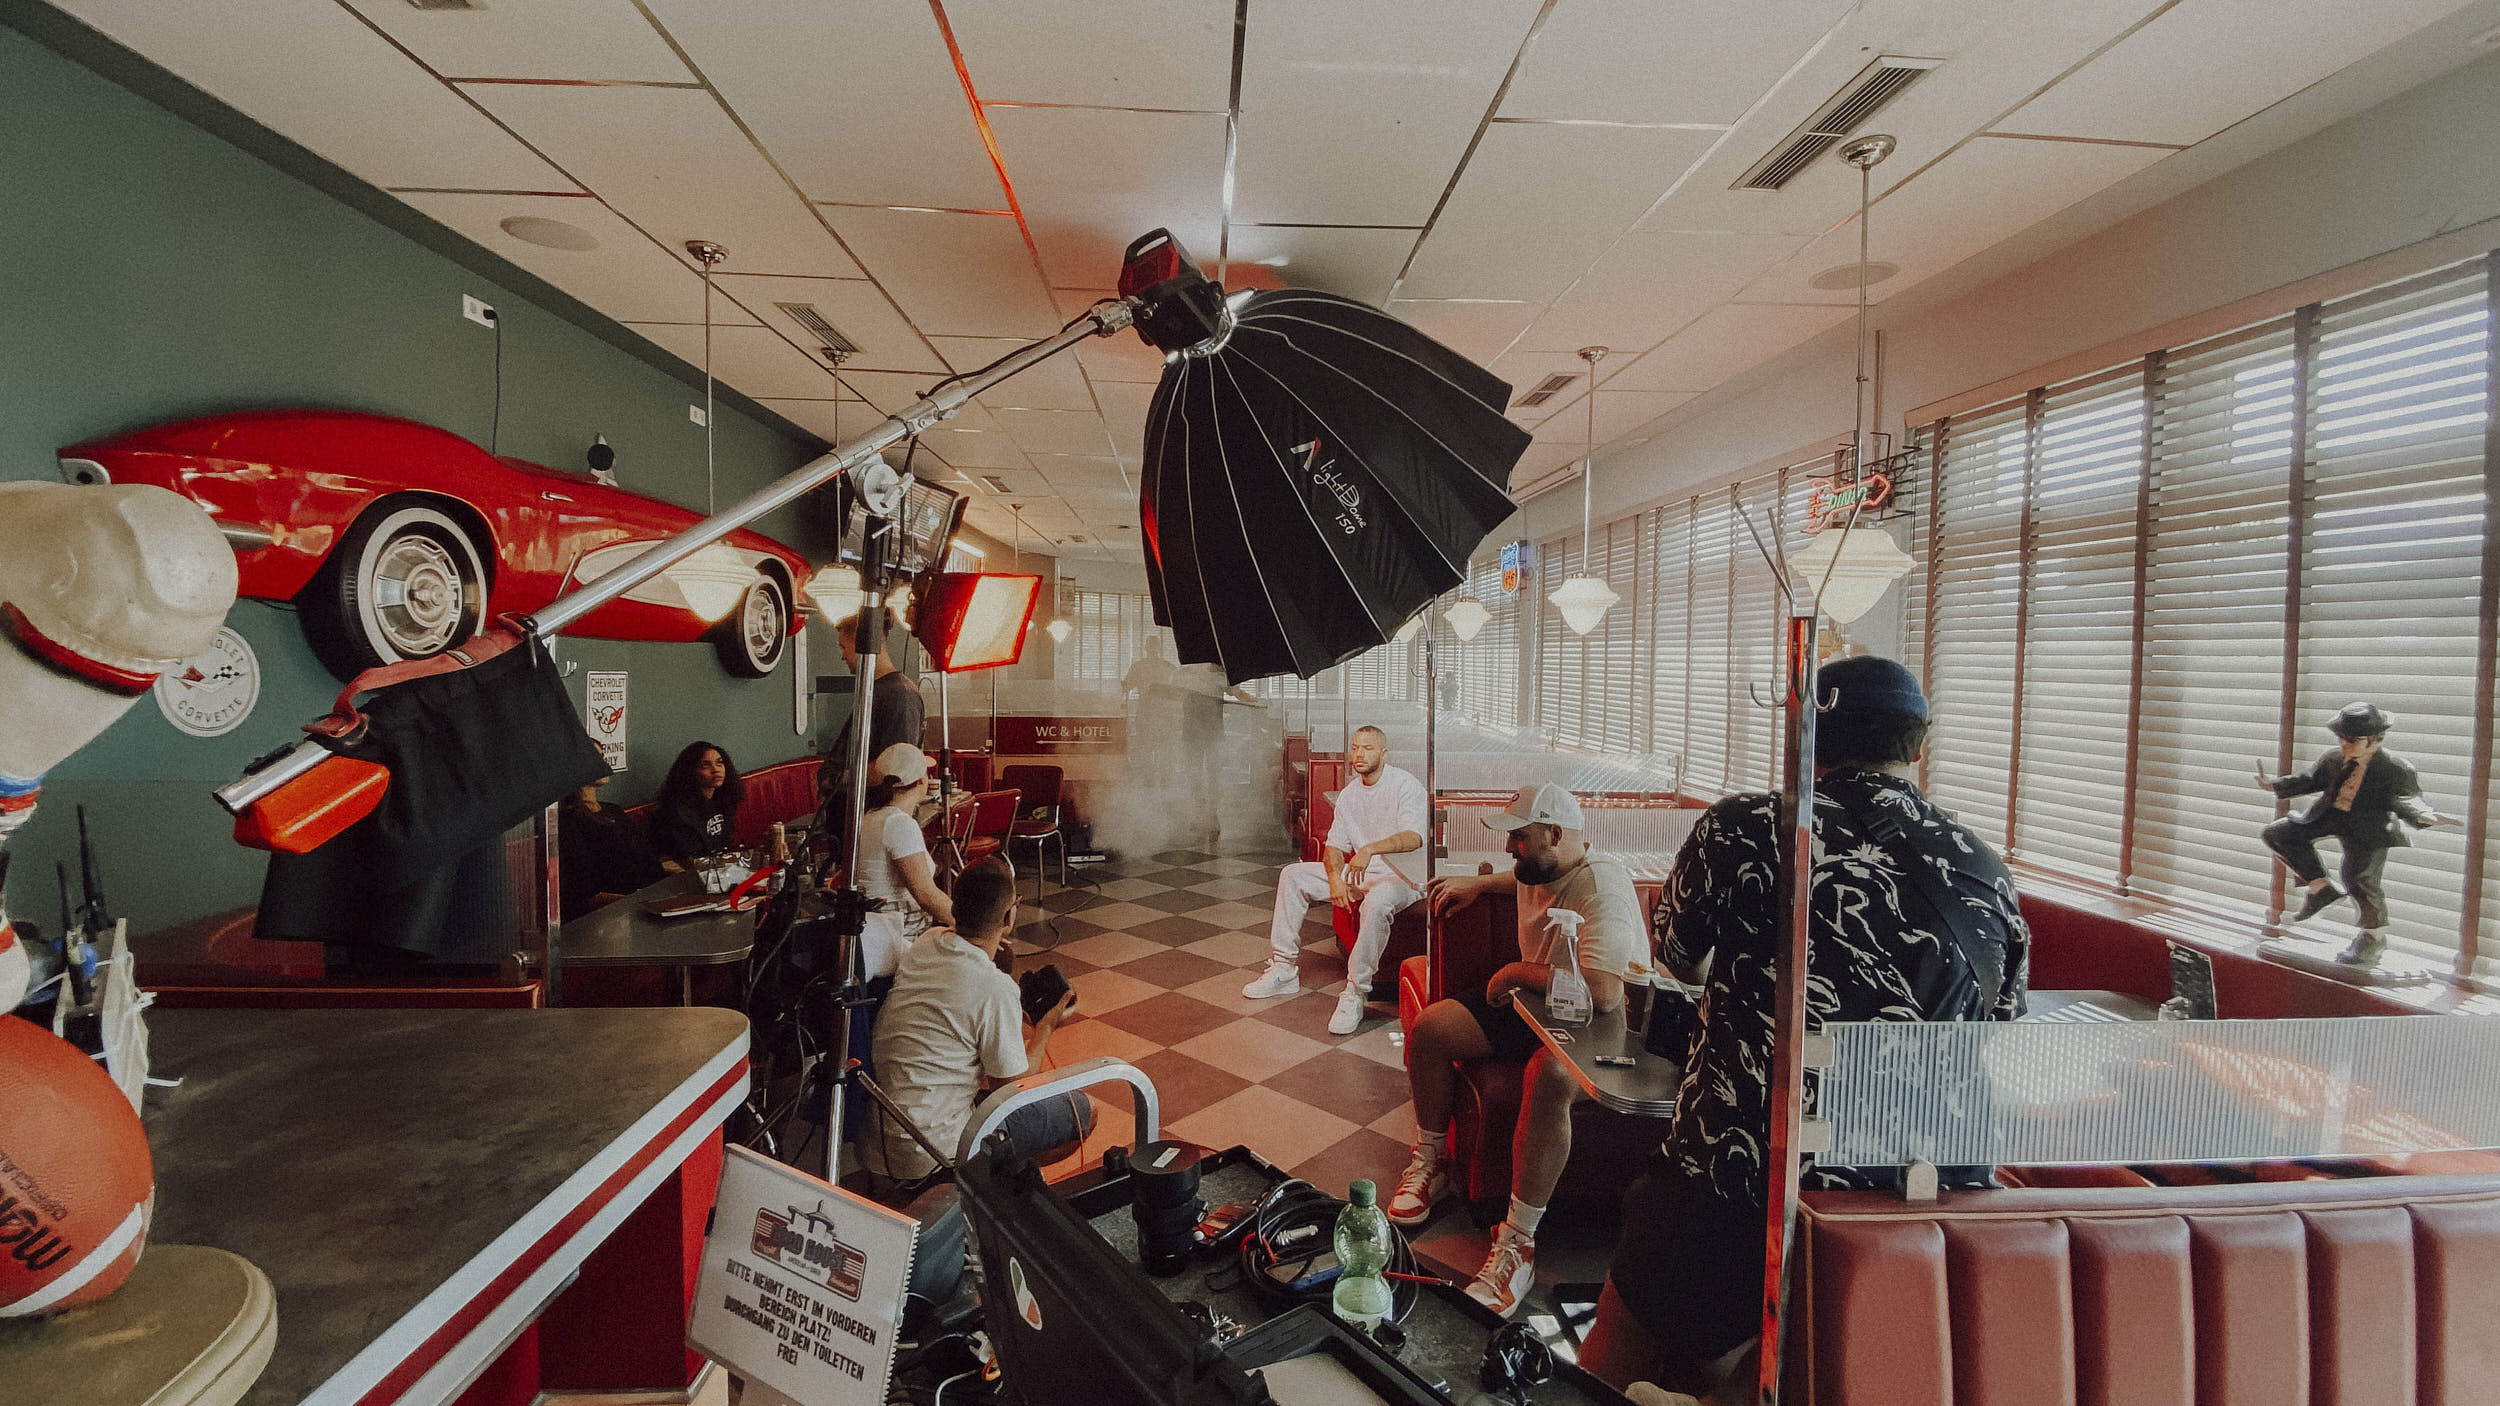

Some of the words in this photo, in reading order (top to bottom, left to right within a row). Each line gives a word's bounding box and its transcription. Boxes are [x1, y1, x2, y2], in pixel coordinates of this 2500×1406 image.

[1335, 513, 1356, 534] 150
[591, 678, 625, 688] CHEVROLET
[592, 691, 624, 702] CORVETTE
[178, 698, 242, 722] CORVETTE
[1035, 726, 1057, 737] WC
[1060, 726, 1070, 737] &
[1073, 726, 1111, 737] HOTEL
[601, 742, 624, 754] RKING
[726, 1258, 752, 1283] BITTE
[752, 1271, 785, 1298] NEHMT
[785, 1287, 810, 1311] ERST
[811, 1300, 825, 1319] IM
[827, 1308, 877, 1346] VORDEREN
[758, 1294, 798, 1325] BEREICH
[798, 1314, 832, 1343] PLATZ!
[723, 1295, 776, 1334] DURCHGANG
[776, 1322, 790, 1341] ZU
[791, 1330, 811, 1353] DEN
[813, 1341, 865, 1382] TOILETTEN
[777, 1343, 799, 1367] FREI
